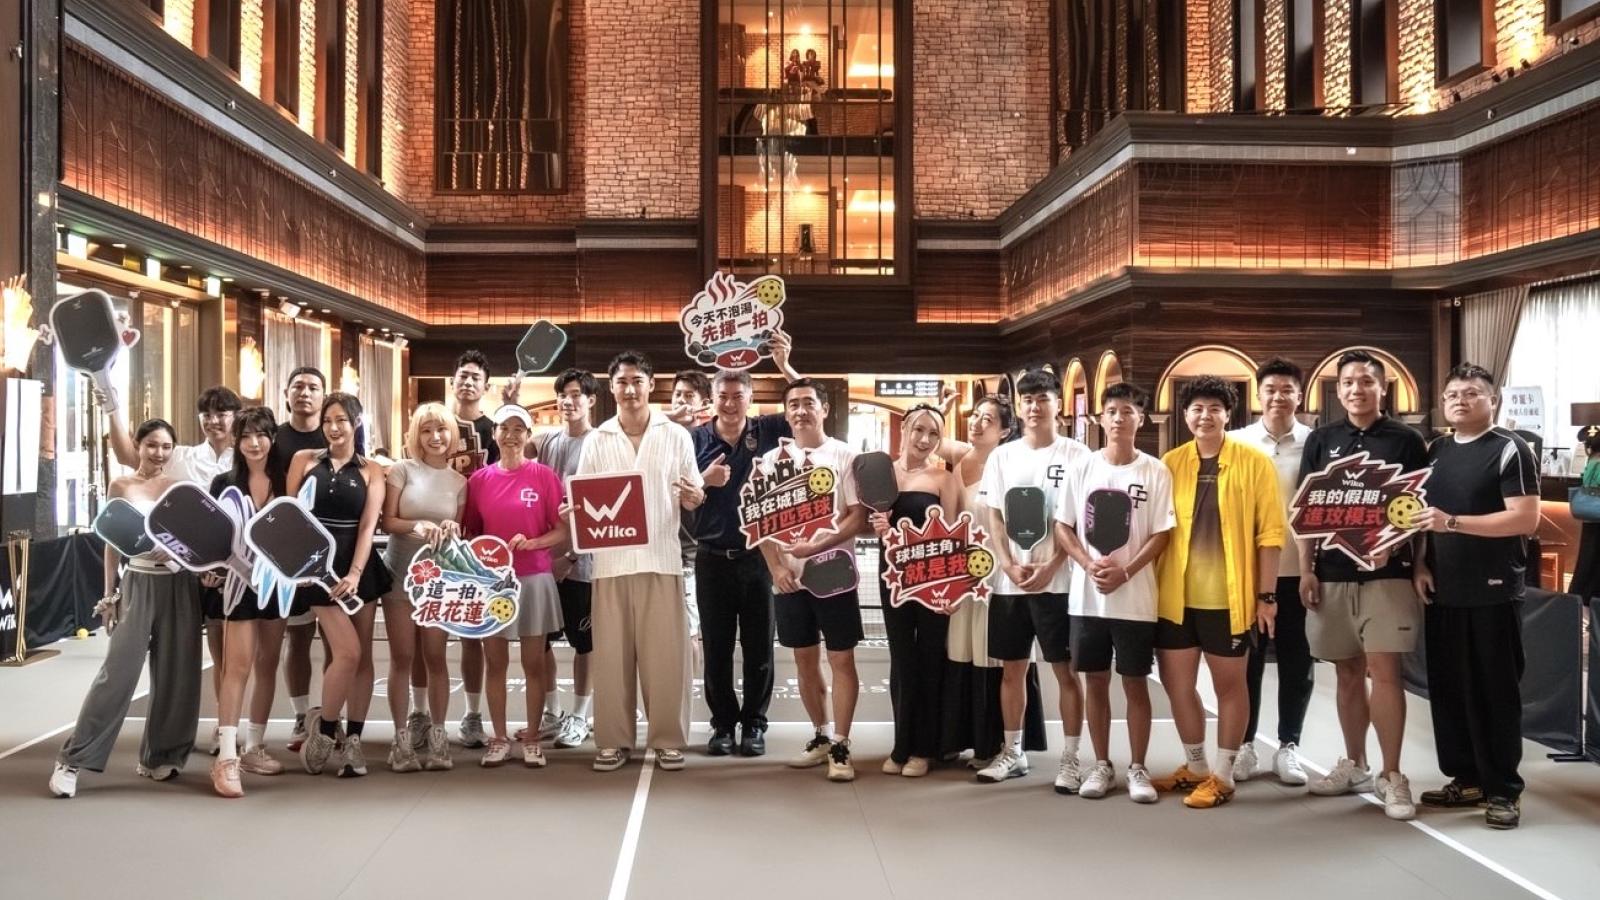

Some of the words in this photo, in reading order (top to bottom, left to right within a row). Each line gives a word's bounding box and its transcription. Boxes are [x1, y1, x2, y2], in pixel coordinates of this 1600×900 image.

[702, 310, 768, 344] 先揮一拍
[745, 486, 808, 522] 我在城堡
[762, 496, 831, 535] 打匹克球
[1303, 506, 1385, 526] 進攻模式
[156, 532, 190, 558] AIR
[587, 525, 637, 539] Wika
[905, 553, 967, 585] 就是我
[416, 600, 485, 624] 很花蓮
